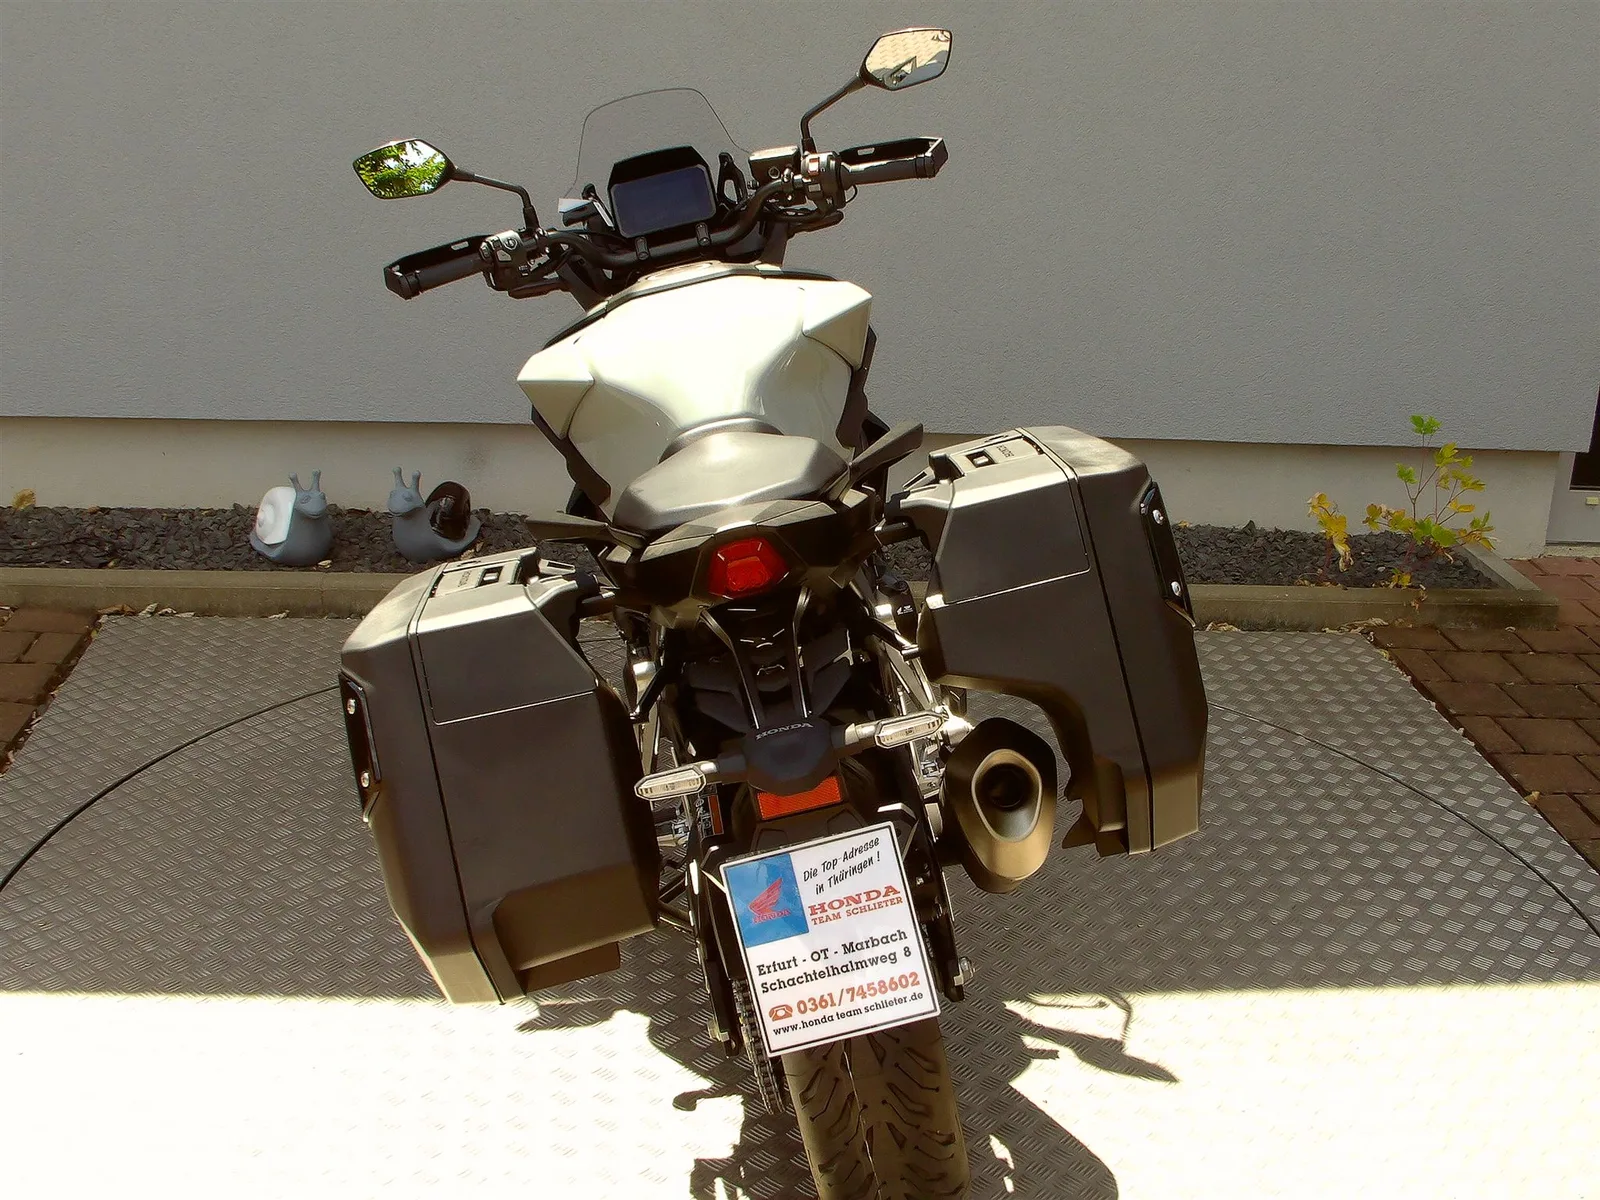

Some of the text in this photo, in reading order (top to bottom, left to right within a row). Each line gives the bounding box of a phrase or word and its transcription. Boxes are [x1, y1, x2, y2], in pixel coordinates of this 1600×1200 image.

[755, 722, 814, 741] HONDA
[803, 837, 880, 882] Die Top-Adresse
[815, 883, 825, 895] in
[827, 856, 874, 889] Thüringen
[752, 908, 792, 925] HONDA
[808, 885, 901, 916] HONDA
[811, 896, 904, 926] TEAM SCHLIETER
[756, 956, 798, 976] Erfurt
[810, 948, 830, 962] OT
[841, 929, 908, 955] Marbach
[760, 946, 912, 994] Schachtelhalmweg 8
[772, 991, 924, 1036] www.honda team schlieter.de
[796, 971, 921, 1015] 0361/7458602
